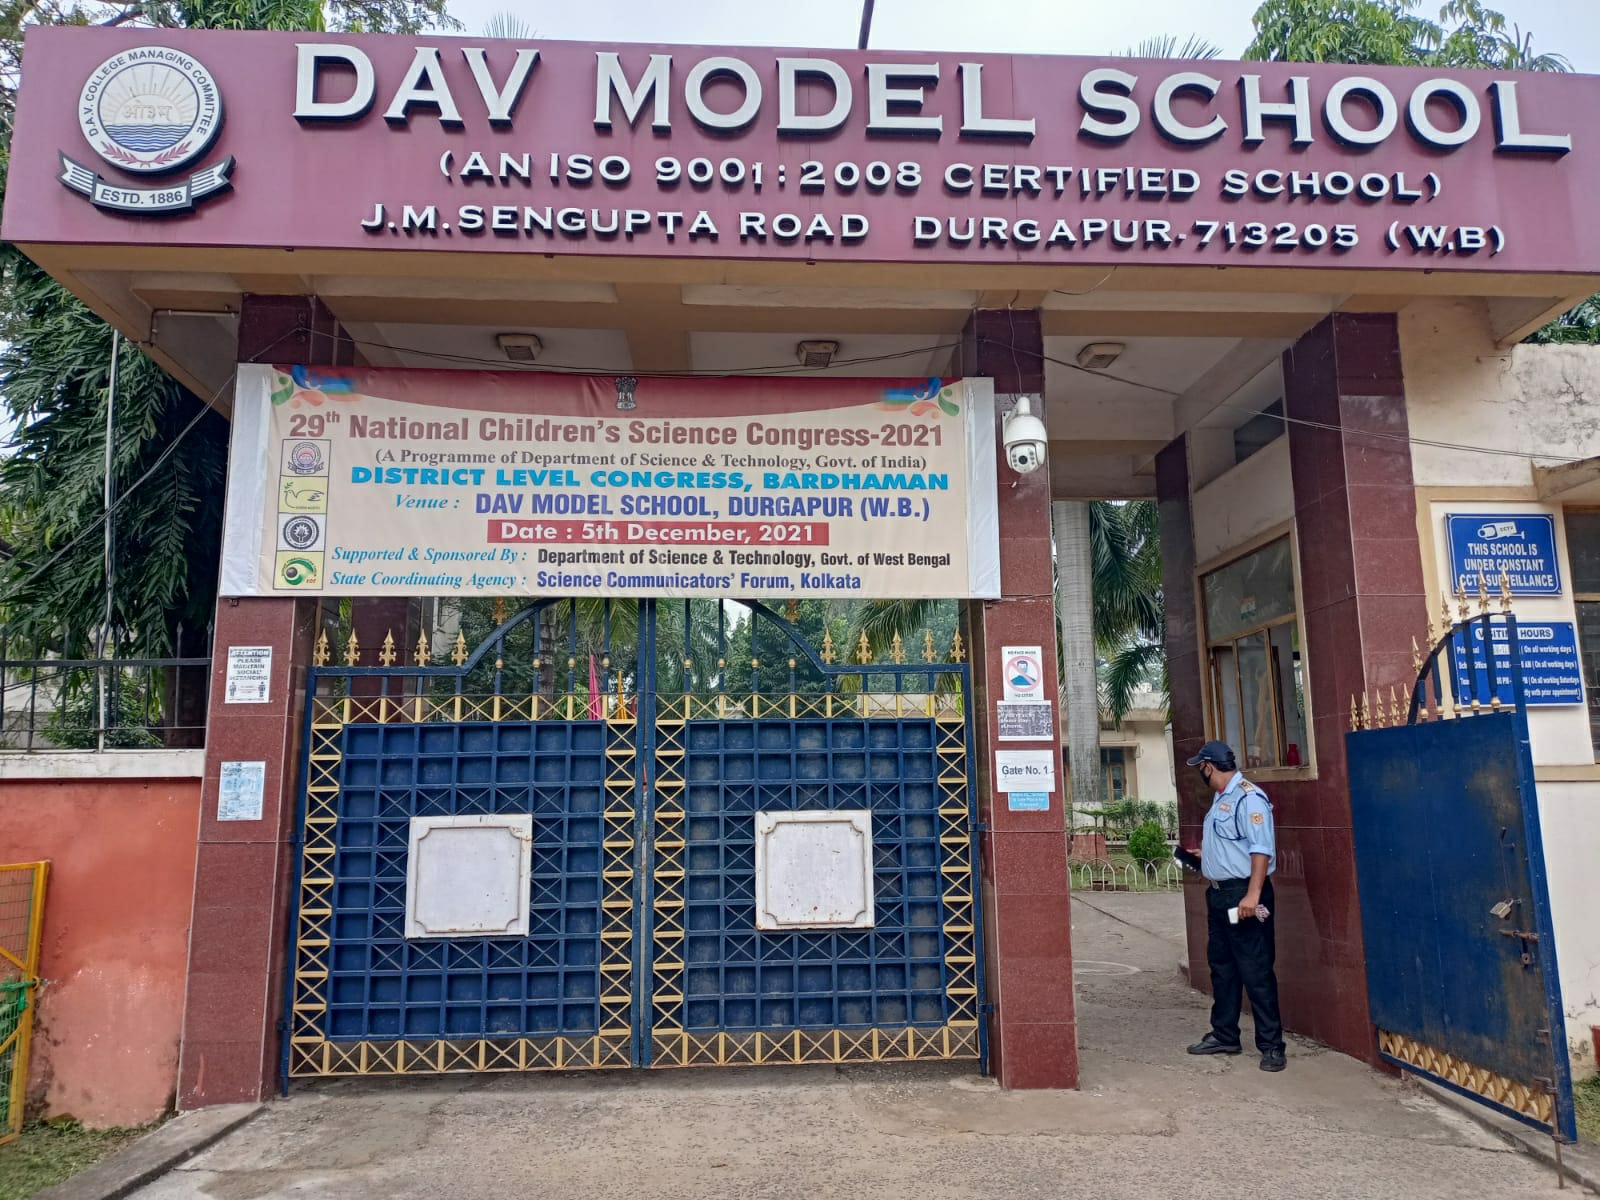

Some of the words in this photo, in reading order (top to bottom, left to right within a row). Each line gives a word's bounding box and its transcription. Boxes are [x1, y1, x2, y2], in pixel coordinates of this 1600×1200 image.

[128, 49, 194, 71] MANAGING
[85, 57, 126, 102] COLLEGE
[192, 69, 216, 136] COMMITTEE
[292, 43, 540, 126] DAV
[592, 51, 1036, 137] MODEL
[1078, 68, 1572, 153] SCHOOL
[83, 104, 99, 137] D.A.V.
[439, 150, 531, 180] (AN
[548, 152, 632, 183] ISO
[944, 162, 1201, 197] CERTIFIED
[1222, 168, 1441, 200] SCHOOL)
[101, 188, 145, 205] ESTD.
[149, 190, 183, 205] 1886
[738, 212, 870, 240] ROAD
[1386, 220, 1505, 256] (W.B)
[289, 411, 341, 438] 29th
[350, 415, 468, 440] National
[479, 417, 621, 444] Children's
[628, 420, 737, 445] Science
[746, 422, 943, 450] Congress-2021
[375, 449, 395, 465] (A
[401, 450, 496, 465] Programme
[500, 450, 518, 464] of
[521, 451, 616, 467] Department
[620, 453, 637, 467] of
[639, 453, 697, 467] Science
[702, 455, 716, 468] &
[721, 454, 811, 471] Technology,
[815, 456, 857, 470] Govt.
[861, 456, 878, 469] of
[880, 455, 927, 471] India)
[352, 466, 485, 486] DISTRICT
[496, 469, 581, 487] LEVEL
[590, 470, 754, 492] CONGRESS,
[763, 472, 948, 491] BARDHAMAN
[396, 494, 449, 509] Venue
[475, 493, 524, 514] DAV
[532, 494, 614, 515] MODEL
[620, 495, 719, 520] SCHOOL,
[728, 496, 853, 518] DURGAPUR
[860, 497, 930, 521] (W.B.)
[501, 522, 558, 540] Date
[581, 522, 618, 540] 5th
[627, 524, 752, 544] December,
[758, 525, 814, 542] 2021
[331, 546, 404, 563] Supported
[408, 548, 419, 561] &
[424, 548, 497, 563] Sponsored
[500, 548, 518, 563] By
[538, 548, 629, 567] Department
[630, 551, 646, 566] of
[649, 550, 708, 566] Science
[712, 551, 725, 566] &
[729, 551, 816, 568] Technology,
[821, 552, 853, 567] Govt.
[857, 552, 871, 567] of
[873, 553, 905, 567] West
[907, 553, 951, 568] Bengal
[1467, 543, 1489, 555] THIS
[1490, 543, 1527, 556] SCHOOL
[1529, 544, 1538, 556] IS
[1464, 559, 1494, 571] UNDER
[1497, 559, 1544, 571] CONSTANT
[330, 571, 366, 586] State
[371, 571, 463, 588] Coordinating
[466, 572, 517, 588] Agency
[537, 571, 602, 588] Science
[607, 572, 736, 589] Communicators'
[740, 573, 796, 591] Forum,
[800, 573, 861, 589] Kolkata
[1460, 574, 1482, 586] CCT
[1520, 629, 1552, 639] HOURS
[1002, 765, 1023, 775] Gate
[1025, 765, 1041, 775] No.
[1043, 765, 1048, 775] 1
